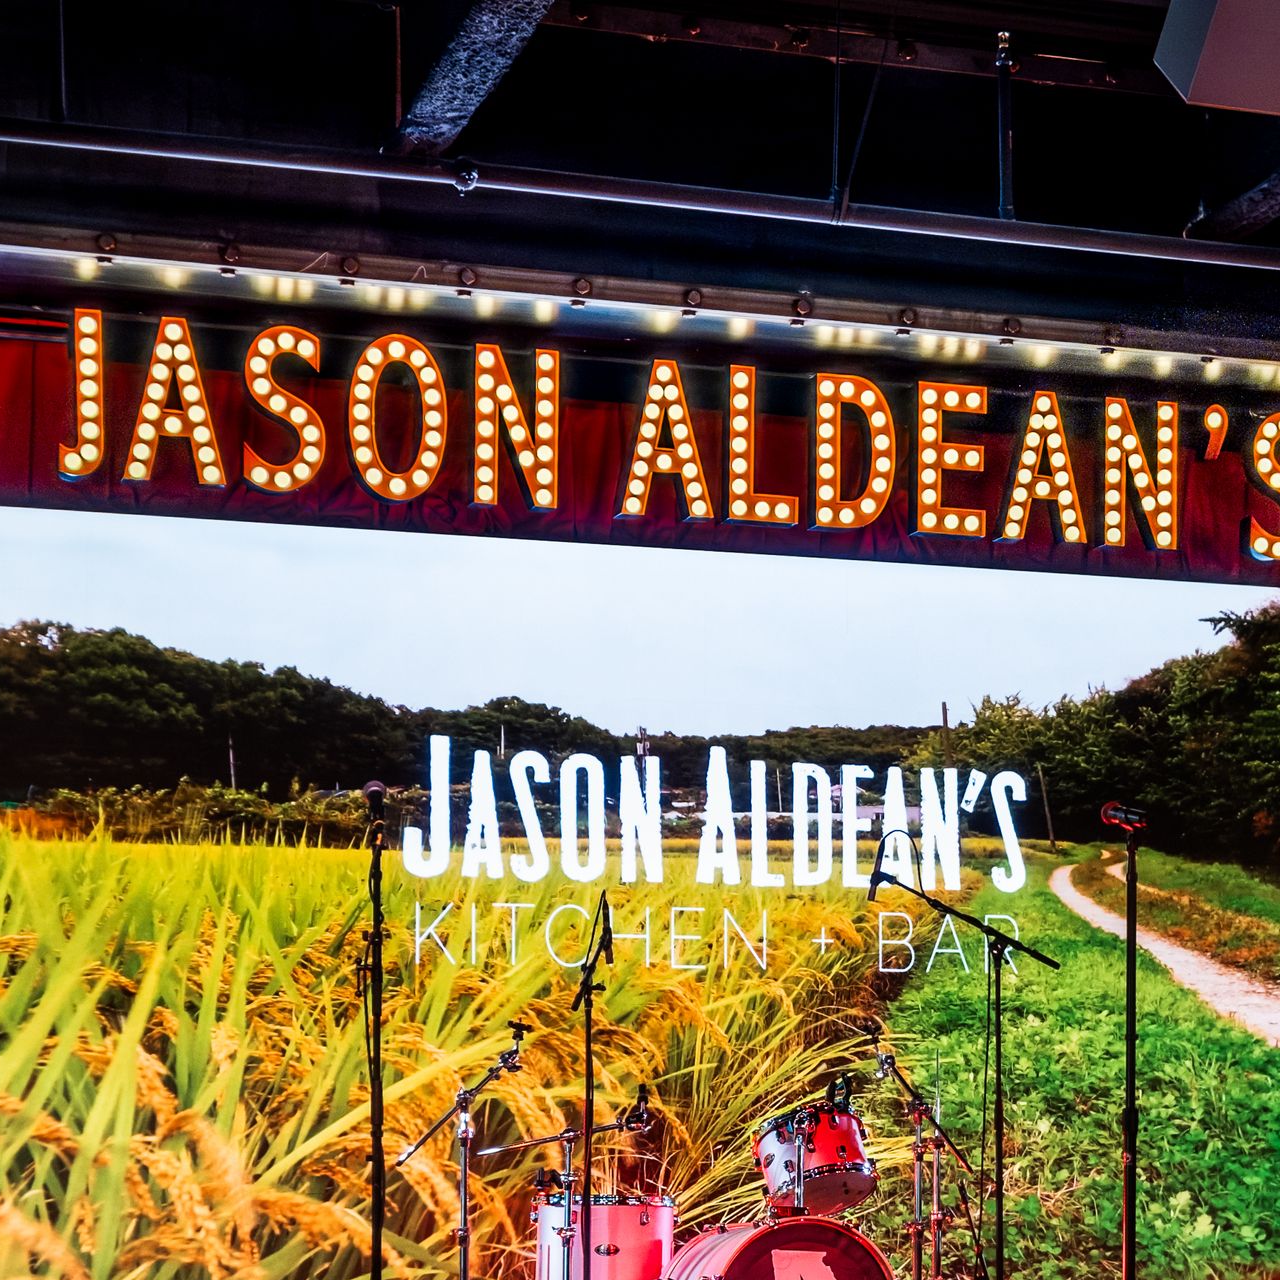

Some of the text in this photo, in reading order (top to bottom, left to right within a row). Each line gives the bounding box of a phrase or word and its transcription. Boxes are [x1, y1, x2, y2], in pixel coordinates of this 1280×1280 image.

[56, 306, 560, 509] JASON
[402, 734, 1027, 893] JASON ALDEAN'S
[413, 900, 768, 972] KITCHEN
[877, 910, 1023, 975] BAR
